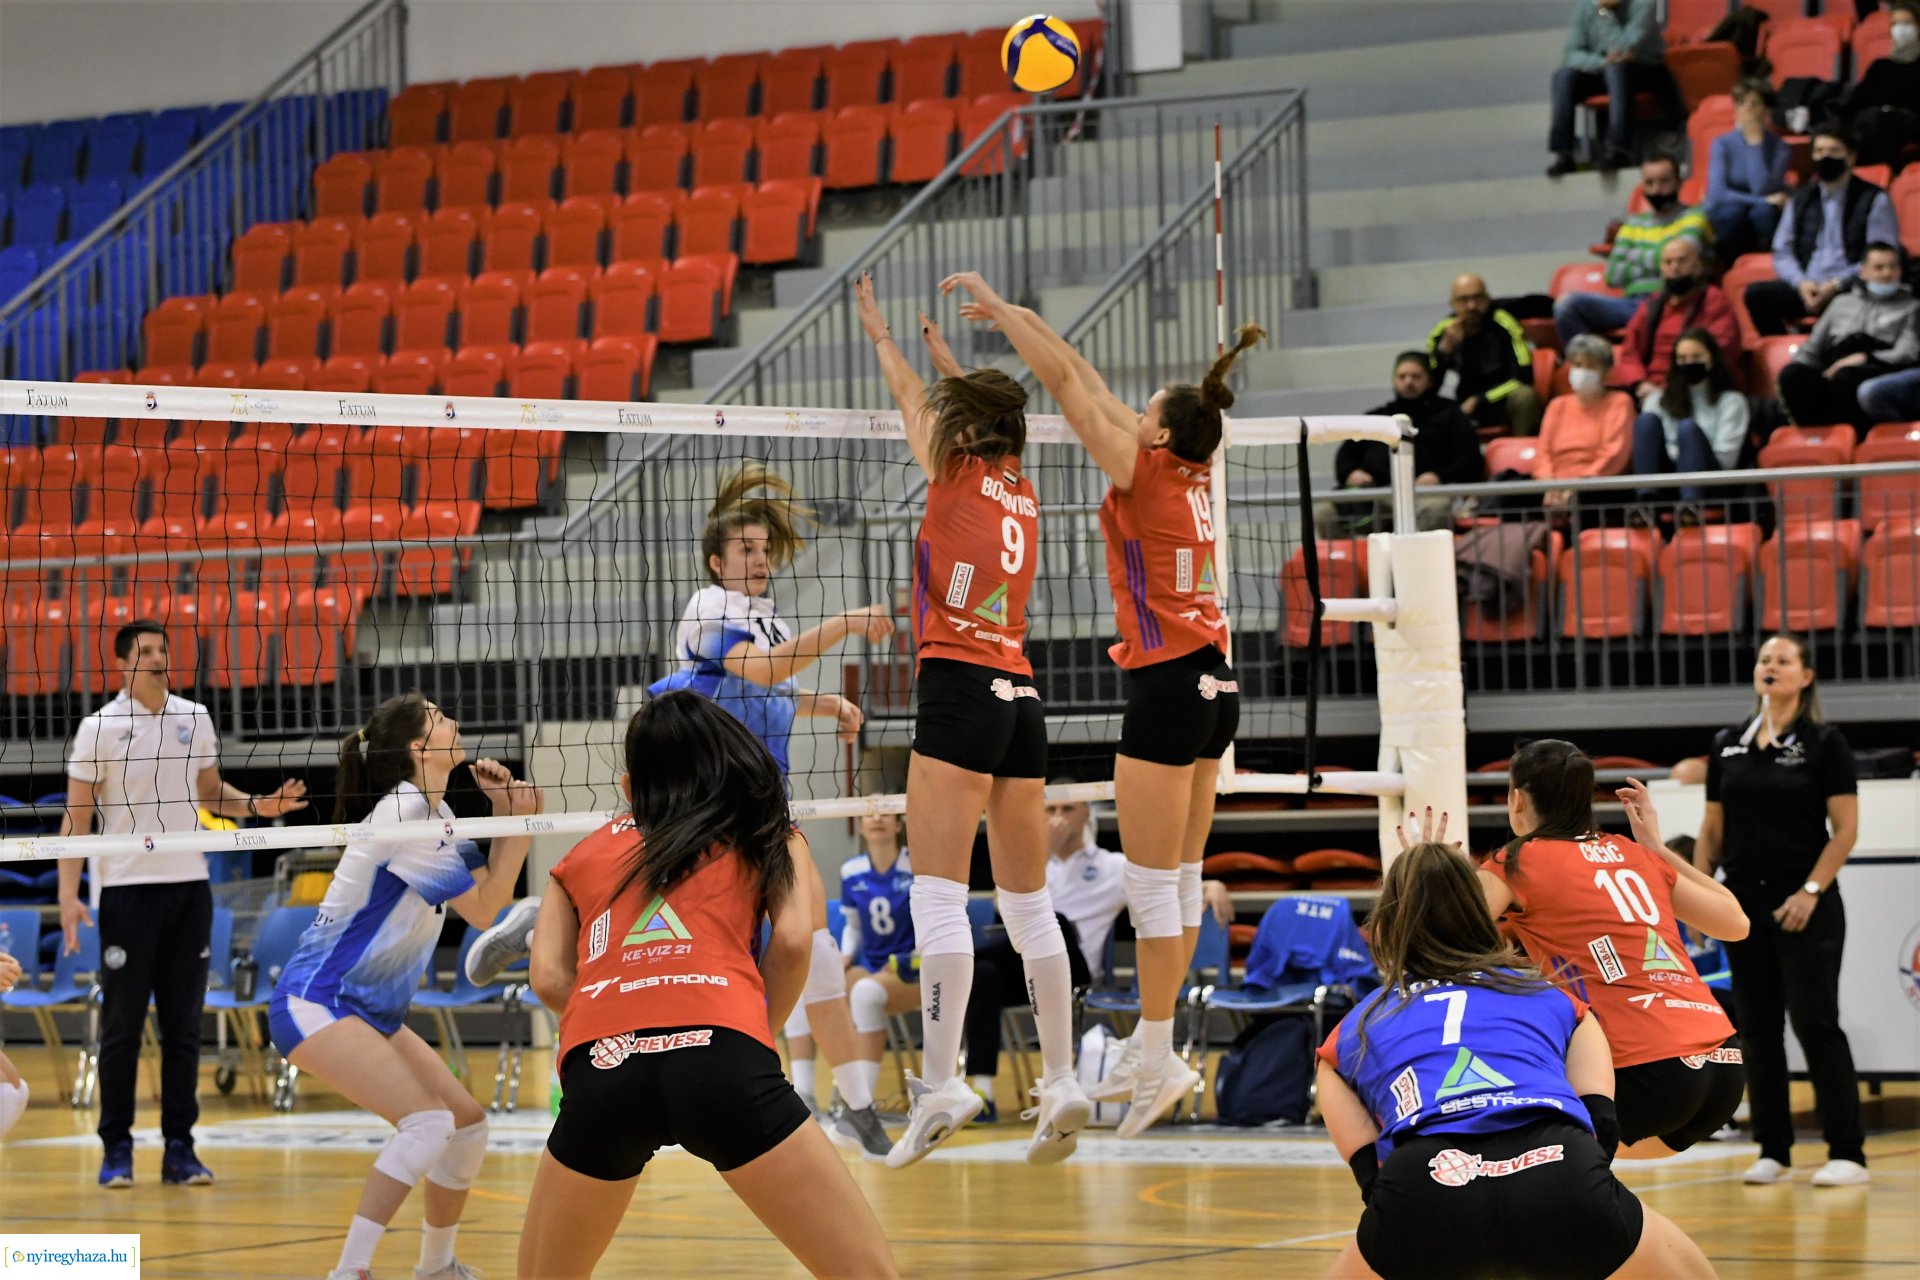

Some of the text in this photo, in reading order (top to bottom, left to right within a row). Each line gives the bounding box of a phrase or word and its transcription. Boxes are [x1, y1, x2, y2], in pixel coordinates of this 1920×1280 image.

[1186, 485, 1216, 542] 19
[1000, 515, 1025, 575] 9
[868, 896, 896, 937] 8
[1594, 868, 1661, 926] 10
[621, 943, 692, 963] KE-VIZ 21
[1596, 940, 1620, 978] STRABAG
[619, 975, 729, 993] BESTRONG
[1423, 989, 1468, 1046] 7
[633, 1031, 712, 1052] REVESZ
[1479, 1145, 1562, 1175] REVESZ
